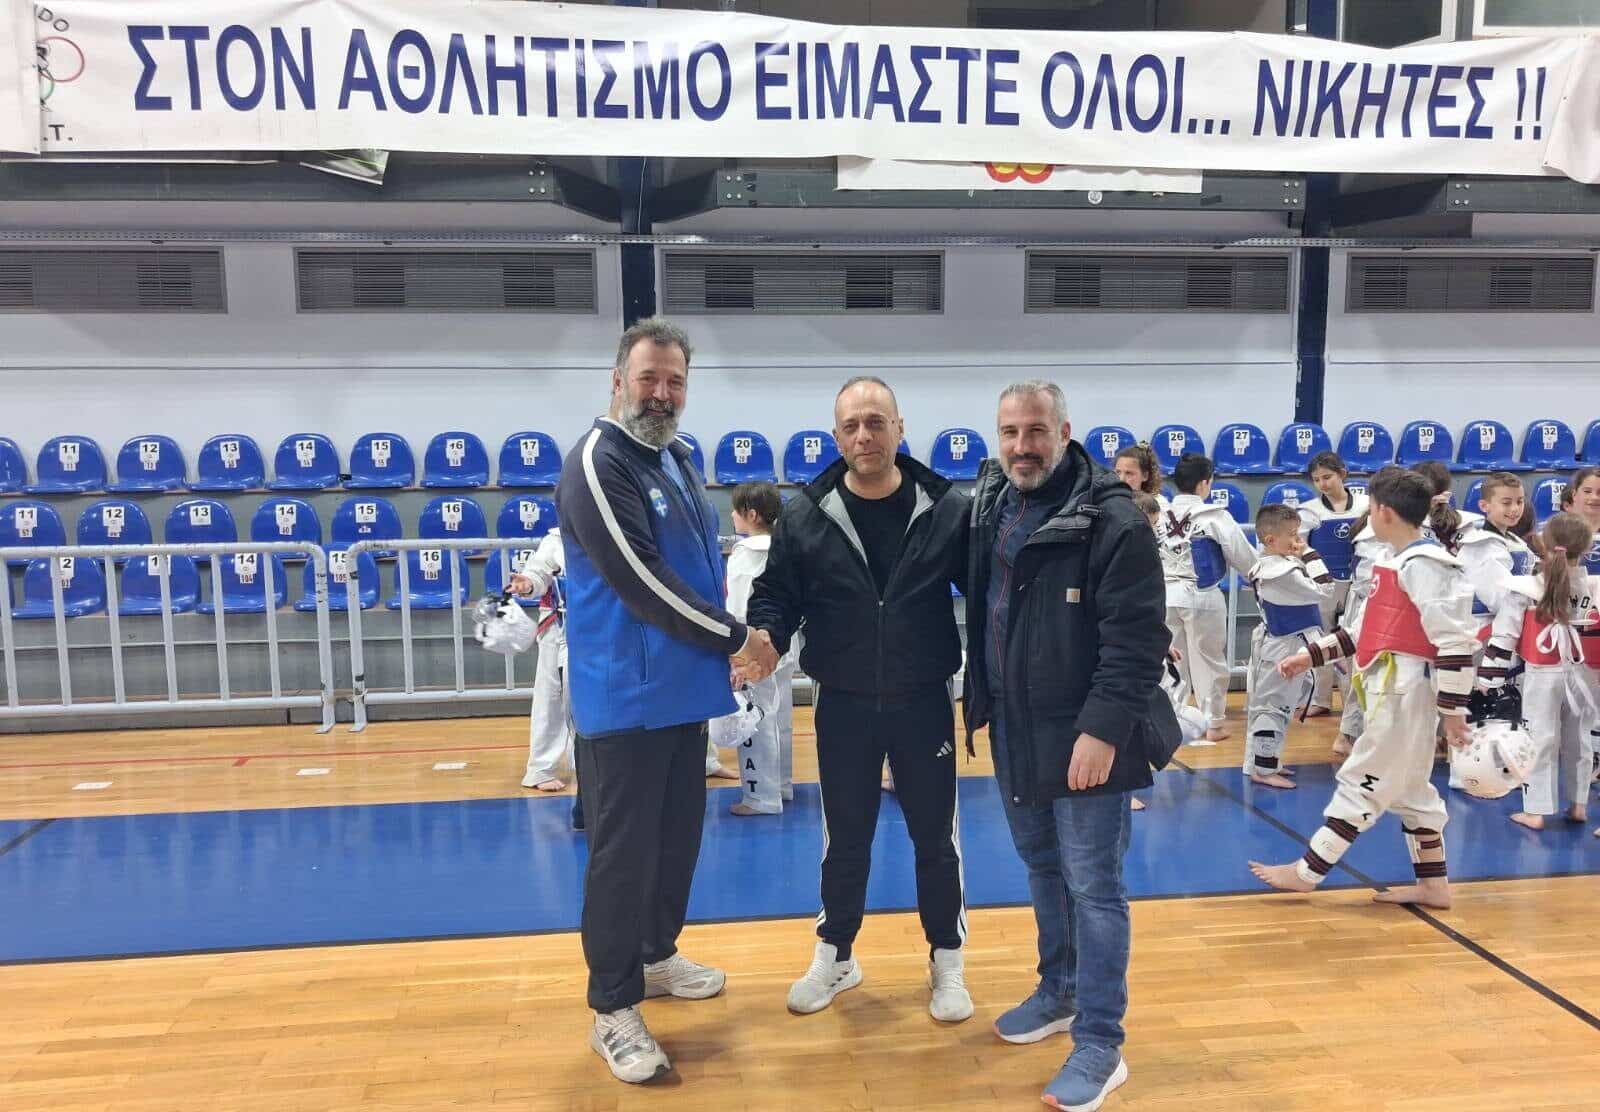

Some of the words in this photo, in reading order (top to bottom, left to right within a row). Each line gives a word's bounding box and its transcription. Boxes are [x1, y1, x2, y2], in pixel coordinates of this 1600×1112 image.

[127, 24, 315, 112] ΣΤΟΝ
[339, 28, 732, 122] ΑΘΛΗΤΙΣΜΟ
[755, 41, 1020, 126] ΕΙΜΑΣΤΕ
[1041, 50, 1231, 135] ΟΛΟΙ...
[1253, 59, 1494, 140] ΝΙΚΗΤΕΣ
[1515, 67, 1546, 141] !!
[1235, 431, 1248, 440] 27
[1298, 431, 1311, 439] 28
[1360, 429, 1373, 438] 29
[1420, 428, 1433, 437] 30
[1481, 427, 1493, 436] 31
[1544, 427, 1556, 436] 32
[952, 436, 966, 445] 23
[1103, 434, 1117, 443] 25
[1170, 433, 1184, 441] 26
[222, 443, 238, 452] 13
[298, 441, 313, 450] 14
[374, 441, 389, 450] 15
[449, 441, 463, 450] 16
[522, 441, 537, 450] 17
[735, 439, 750, 448] 20
[806, 439, 819, 448] 21
[62, 444, 77, 454] 11
[142, 444, 158, 453] 12
[192, 507, 209, 517] 13
[278, 506, 295, 516] 14
[357, 505, 374, 515] 15
[445, 504, 461, 513] 16
[18, 509, 34, 519] 11
[105, 509, 122, 518] 12
[237, 555, 255, 565] 14
[423, 552, 440, 562] 16
[516, 550, 531, 561] 17
